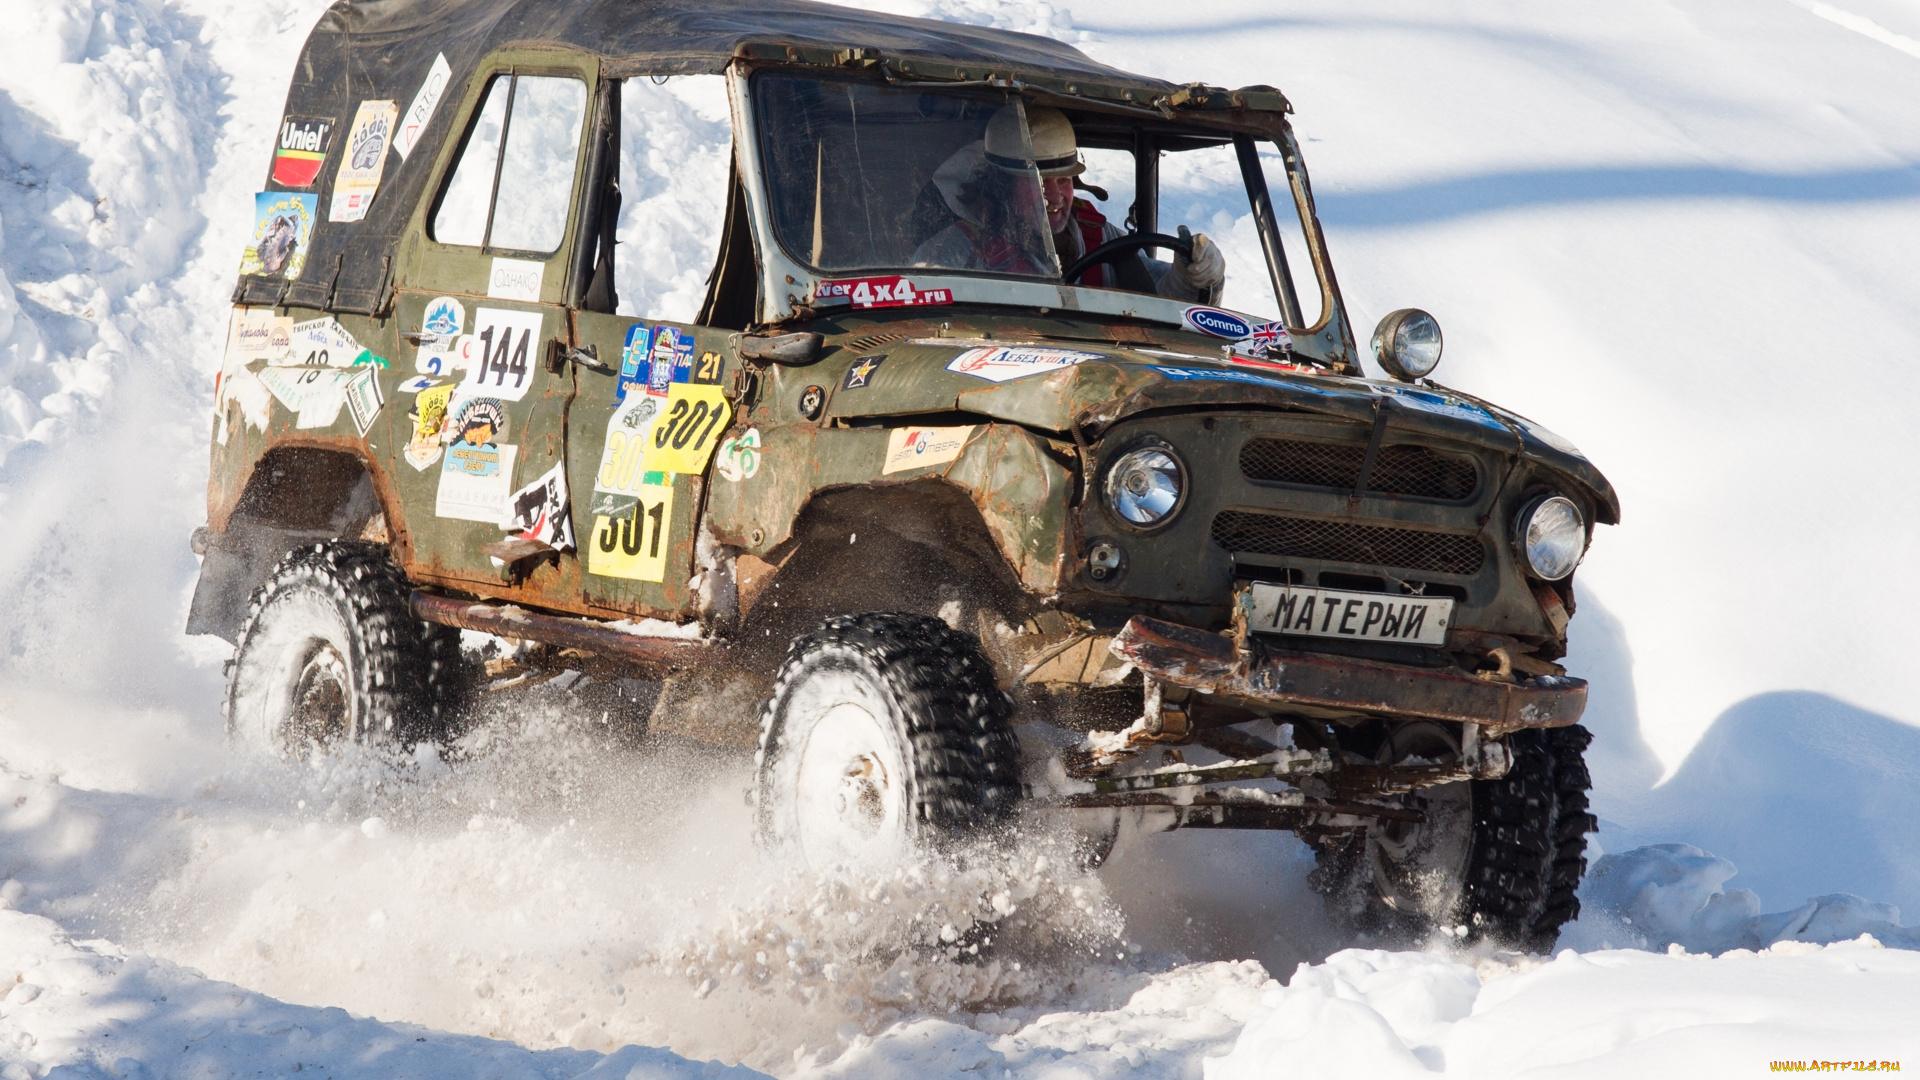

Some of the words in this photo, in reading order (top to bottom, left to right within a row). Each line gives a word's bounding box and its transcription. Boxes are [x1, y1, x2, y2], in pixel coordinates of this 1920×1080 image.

[280, 121, 322, 152] Uniel
[494, 268, 538, 292] ОДНАКО
[1196, 313, 1245, 334] Comma
[476, 324, 531, 388] 144
[698, 352, 721, 379] 21
[656, 398, 725, 451] 301
[1272, 593, 1428, 639] МАТЕРЫЙ
